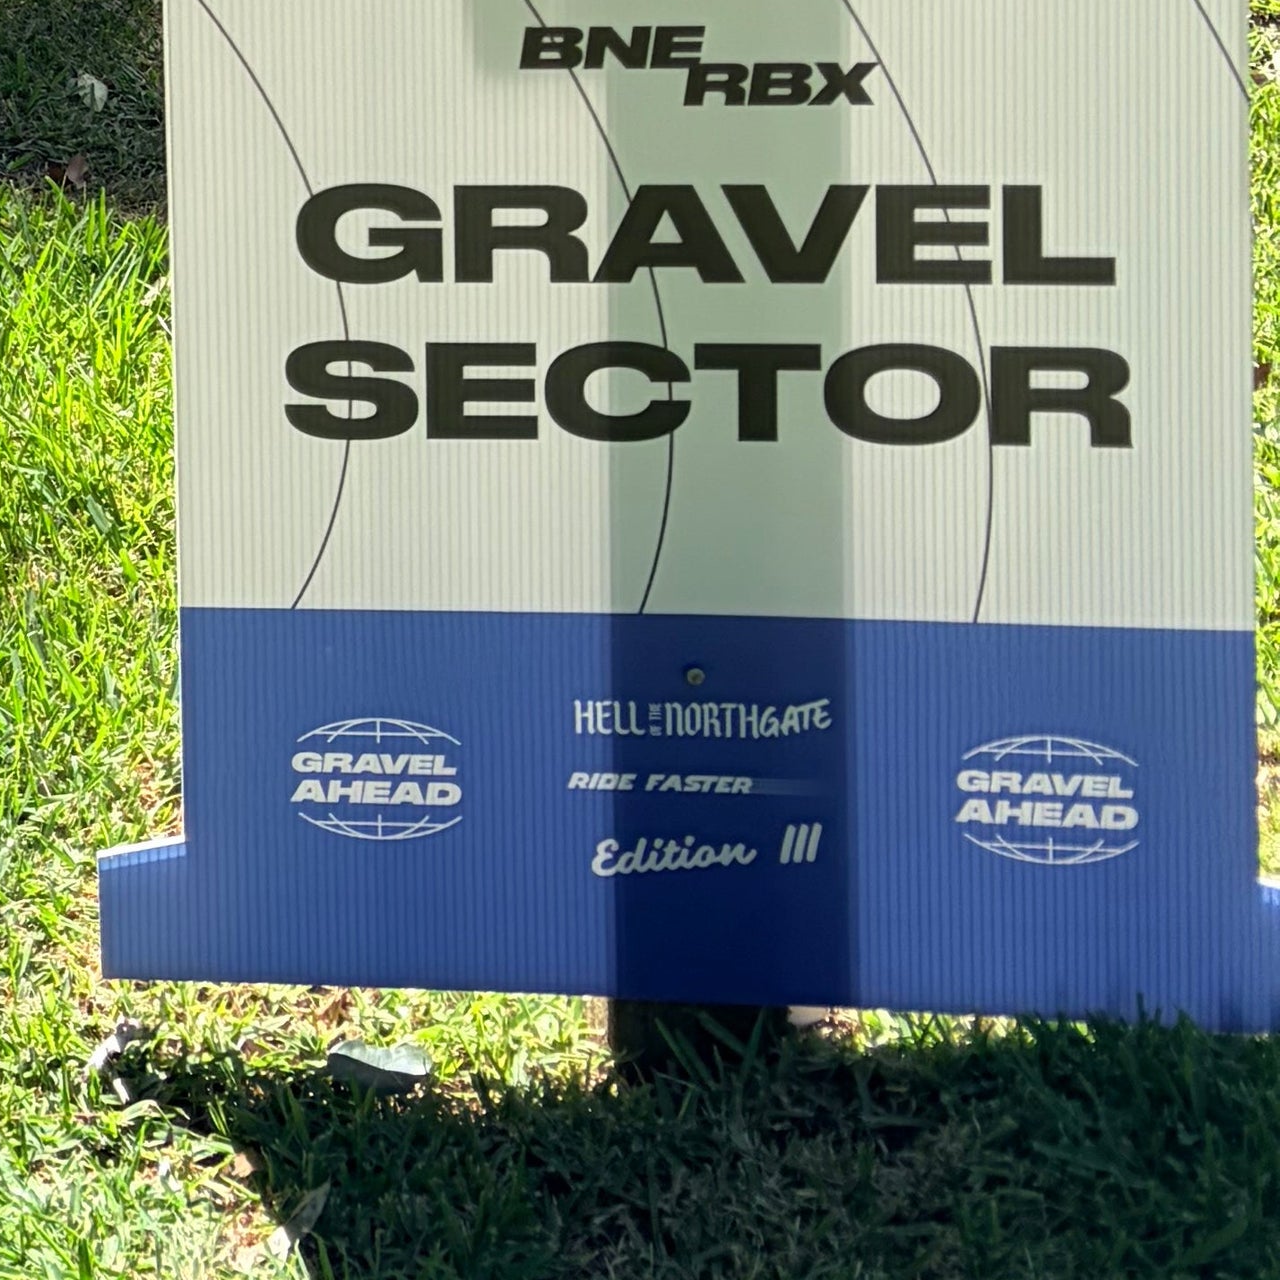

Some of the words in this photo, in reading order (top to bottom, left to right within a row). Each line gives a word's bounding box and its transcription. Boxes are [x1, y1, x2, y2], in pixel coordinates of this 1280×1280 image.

[519, 25, 706, 70] BNE
[683, 62, 880, 107] RBX
[295, 183, 1116, 285] GRAVEL
[283, 340, 1132, 448] SECTOR
[574, 699, 646, 735] HELL
[663, 698, 832, 739] NORTHGATE
[291, 752, 458, 776] GRAVEL
[290, 779, 463, 806] AHEAD
[567, 772, 637, 791] RIDE
[644, 773, 753, 794] FASTER
[956, 769, 1134, 799] GRAVEL
[955, 798, 1140, 830] AHEAD
[591, 835, 758, 877] Edition
